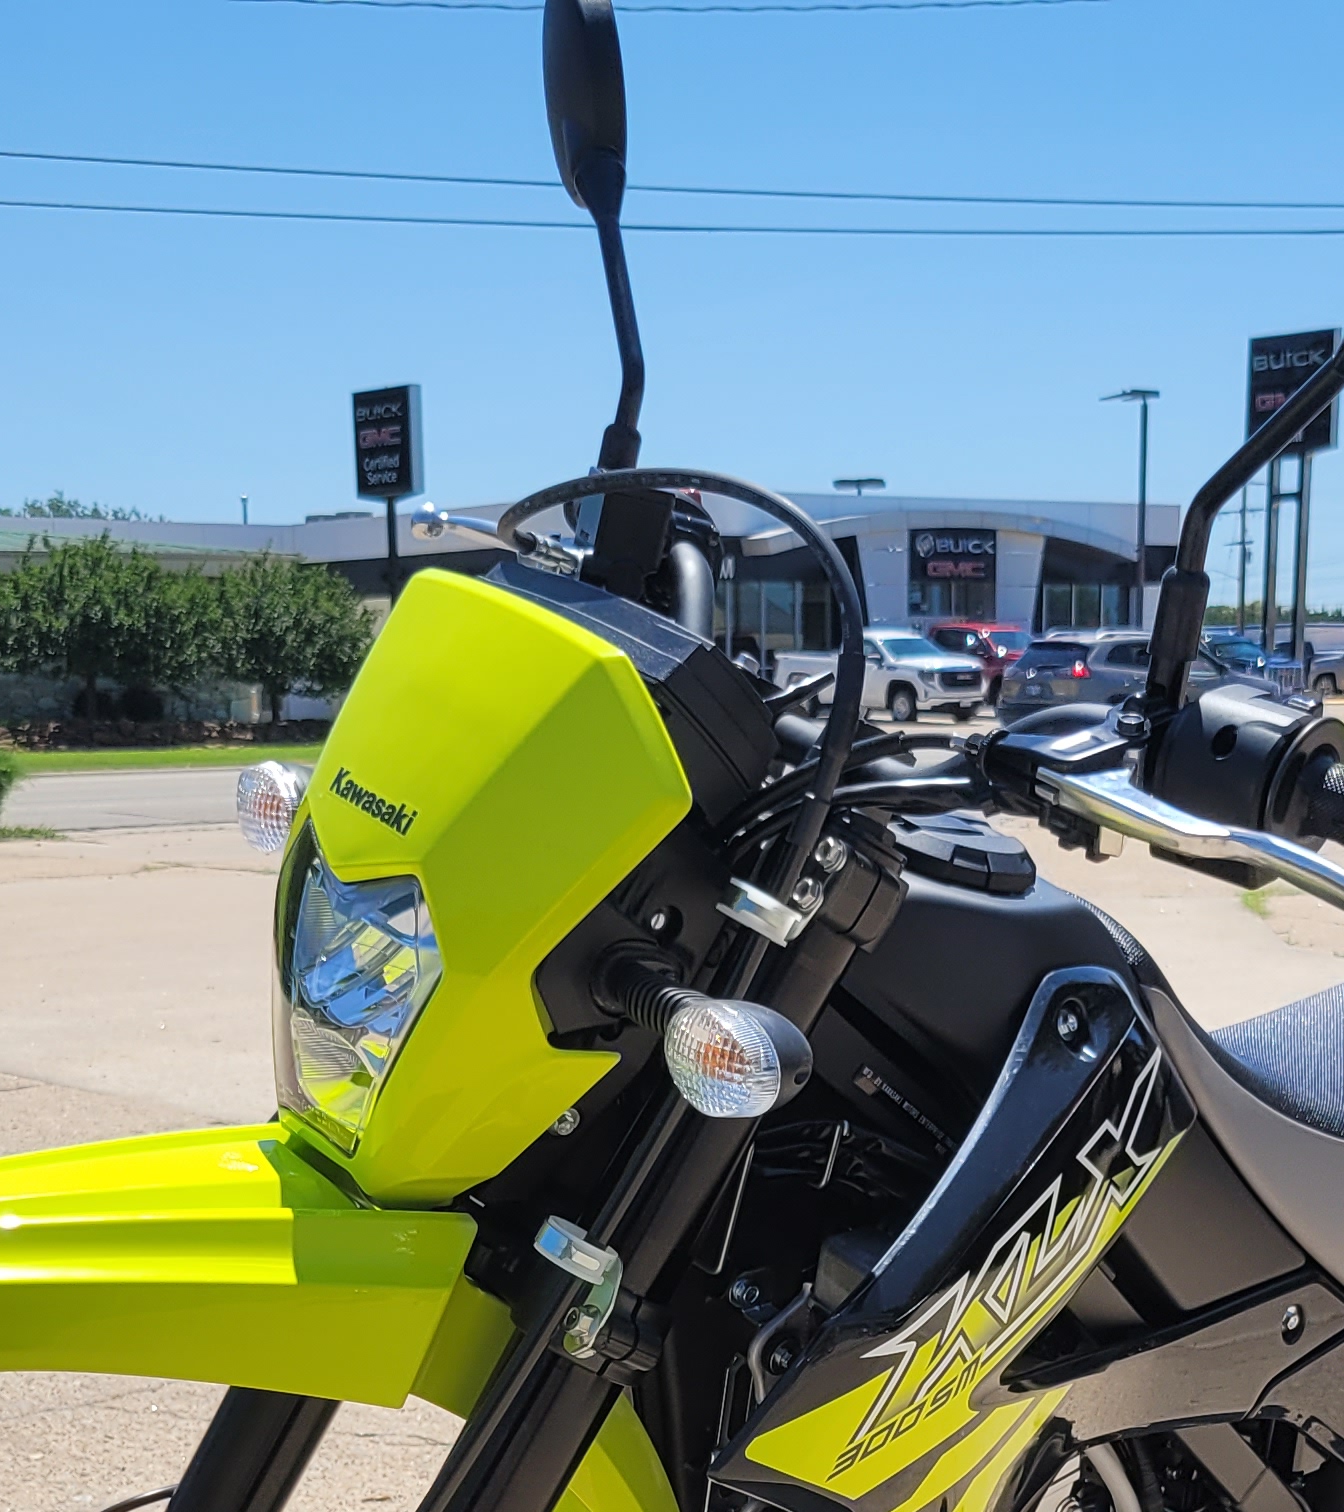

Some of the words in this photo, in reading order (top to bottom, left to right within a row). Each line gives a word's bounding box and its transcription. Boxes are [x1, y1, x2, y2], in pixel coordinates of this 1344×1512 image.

[1253, 349, 1325, 372] BUICK
[357, 402, 404, 422] BUICK
[359, 426, 402, 449] GMC
[367, 471, 398, 486] Service
[936, 538, 995, 554] BUICK
[927, 561, 985, 577] GMC
[329, 766, 419, 837] Kawasaki
